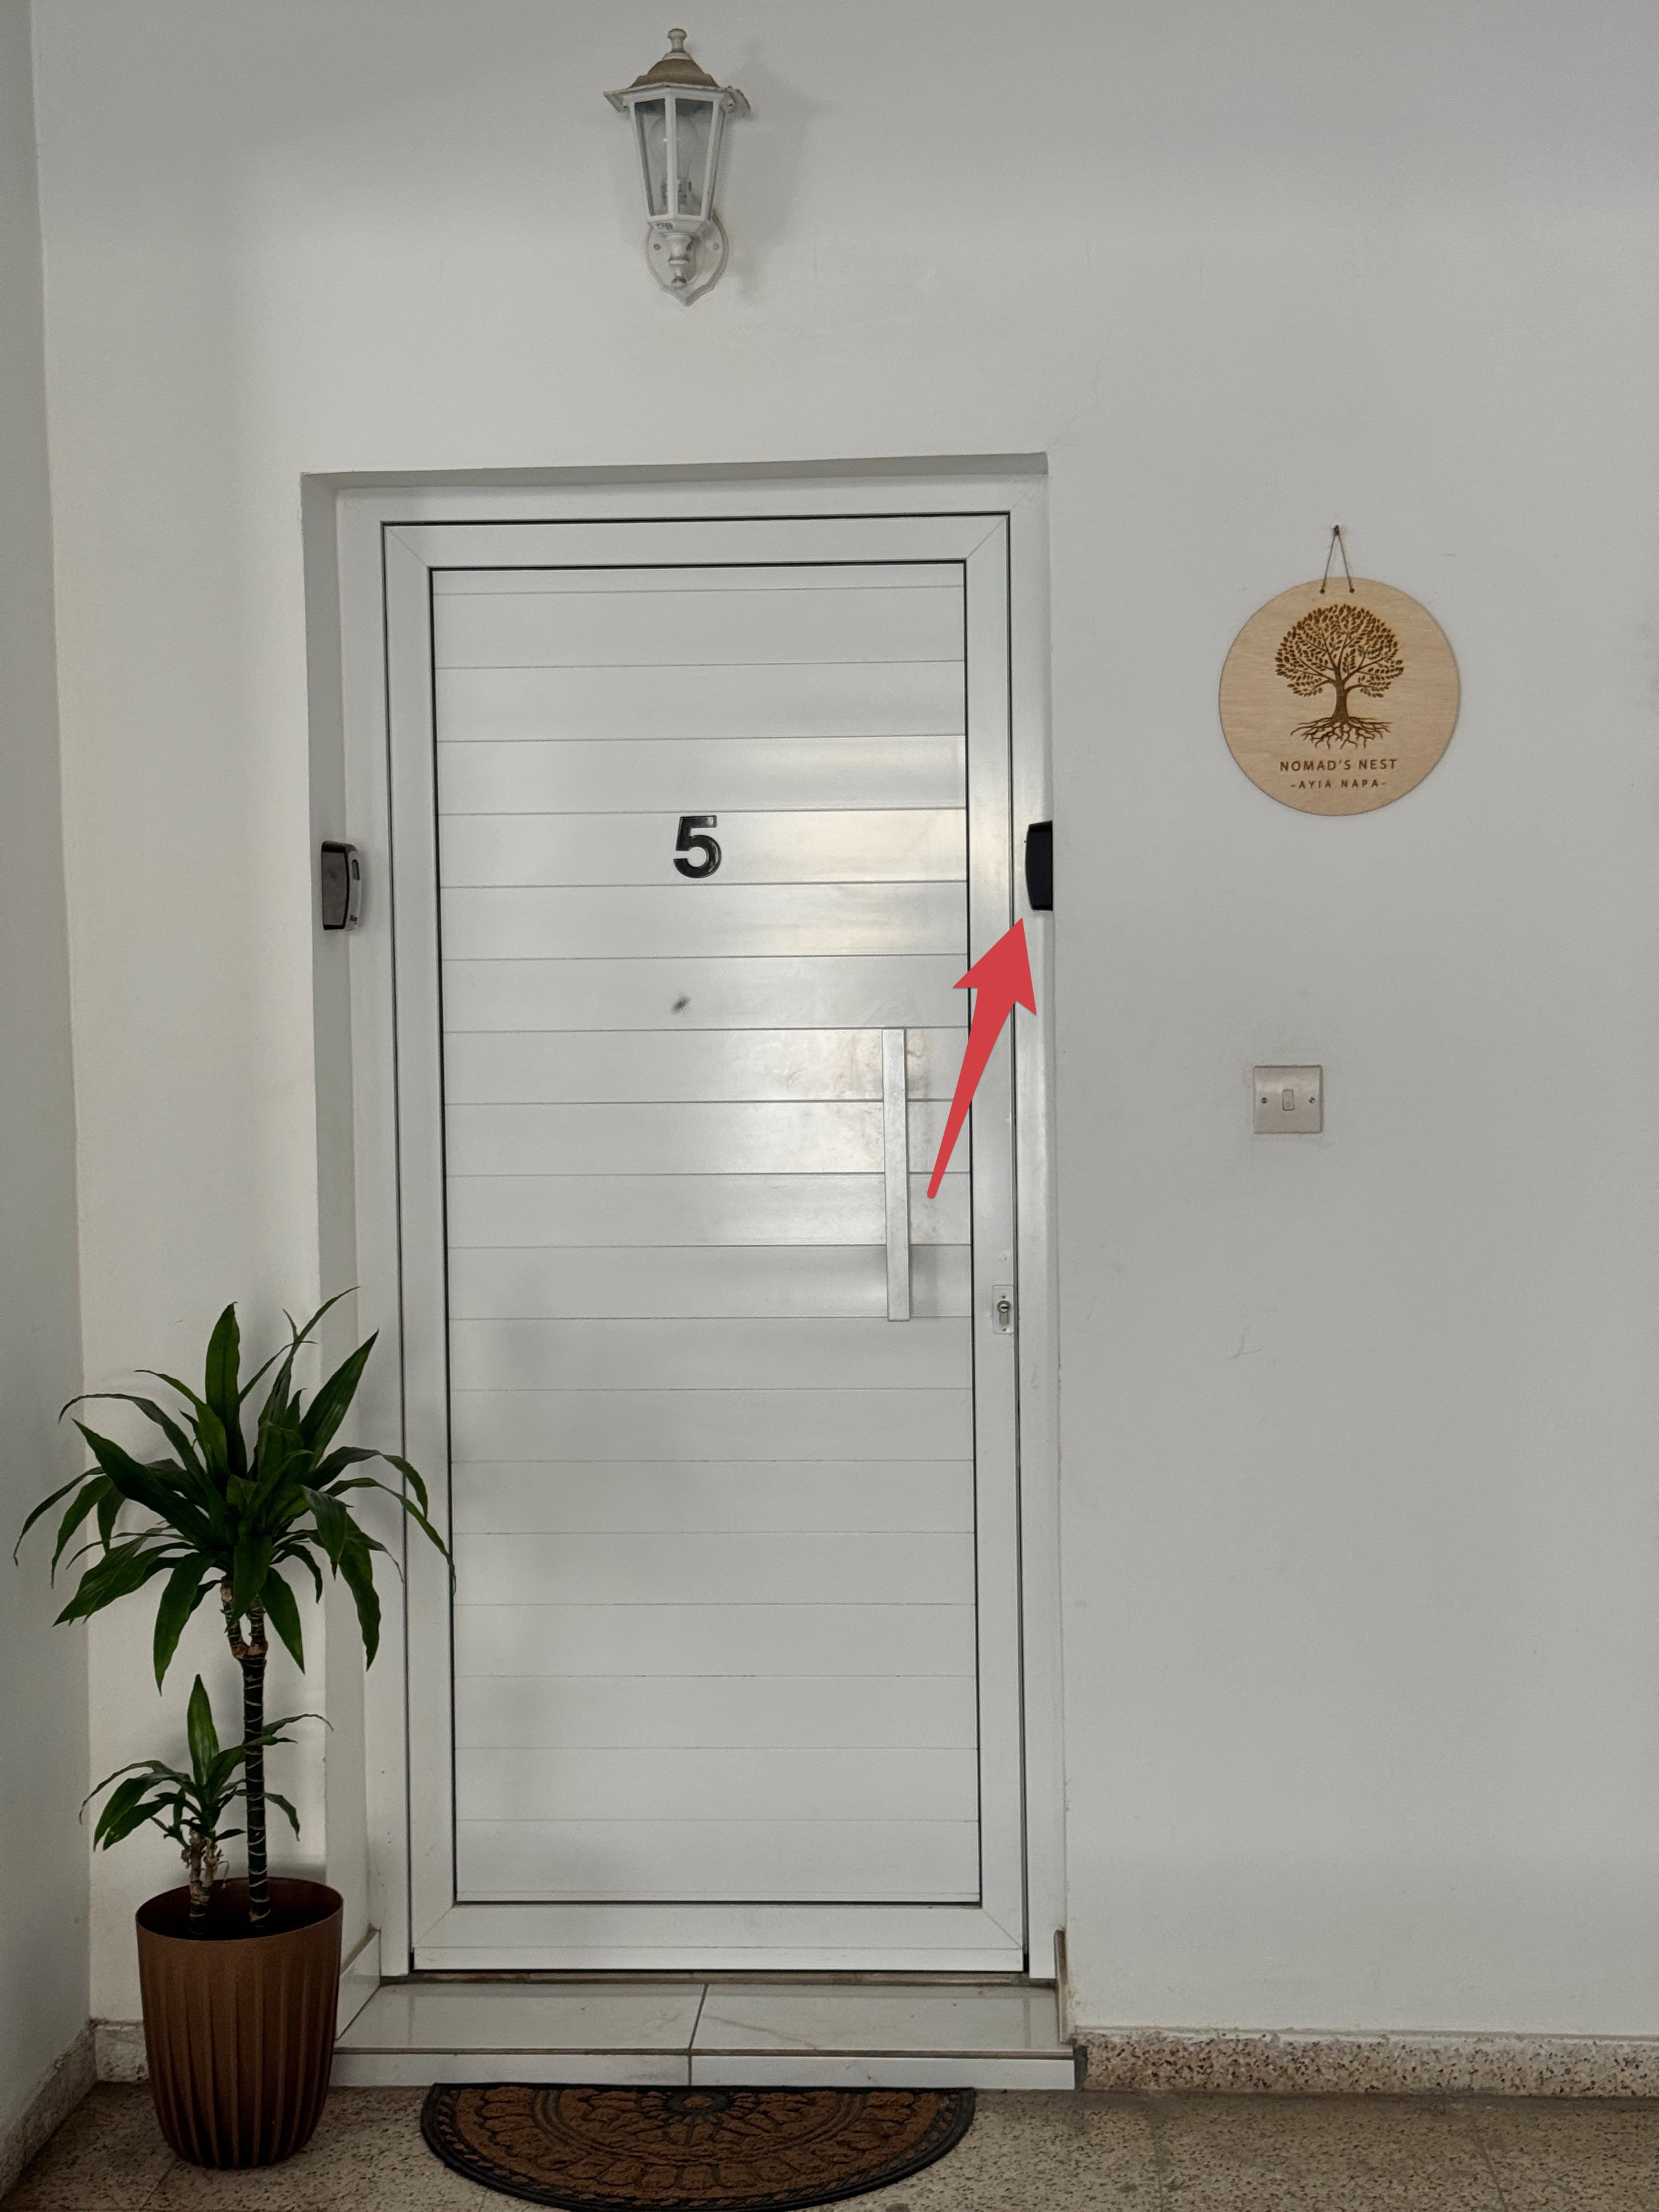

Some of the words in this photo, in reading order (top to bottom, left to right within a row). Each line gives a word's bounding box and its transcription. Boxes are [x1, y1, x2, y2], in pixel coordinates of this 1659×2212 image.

[1280, 759, 1351, 772] NOMAD'S
[1358, 758, 1397, 770] NEST
[673, 815, 722, 879] 5
